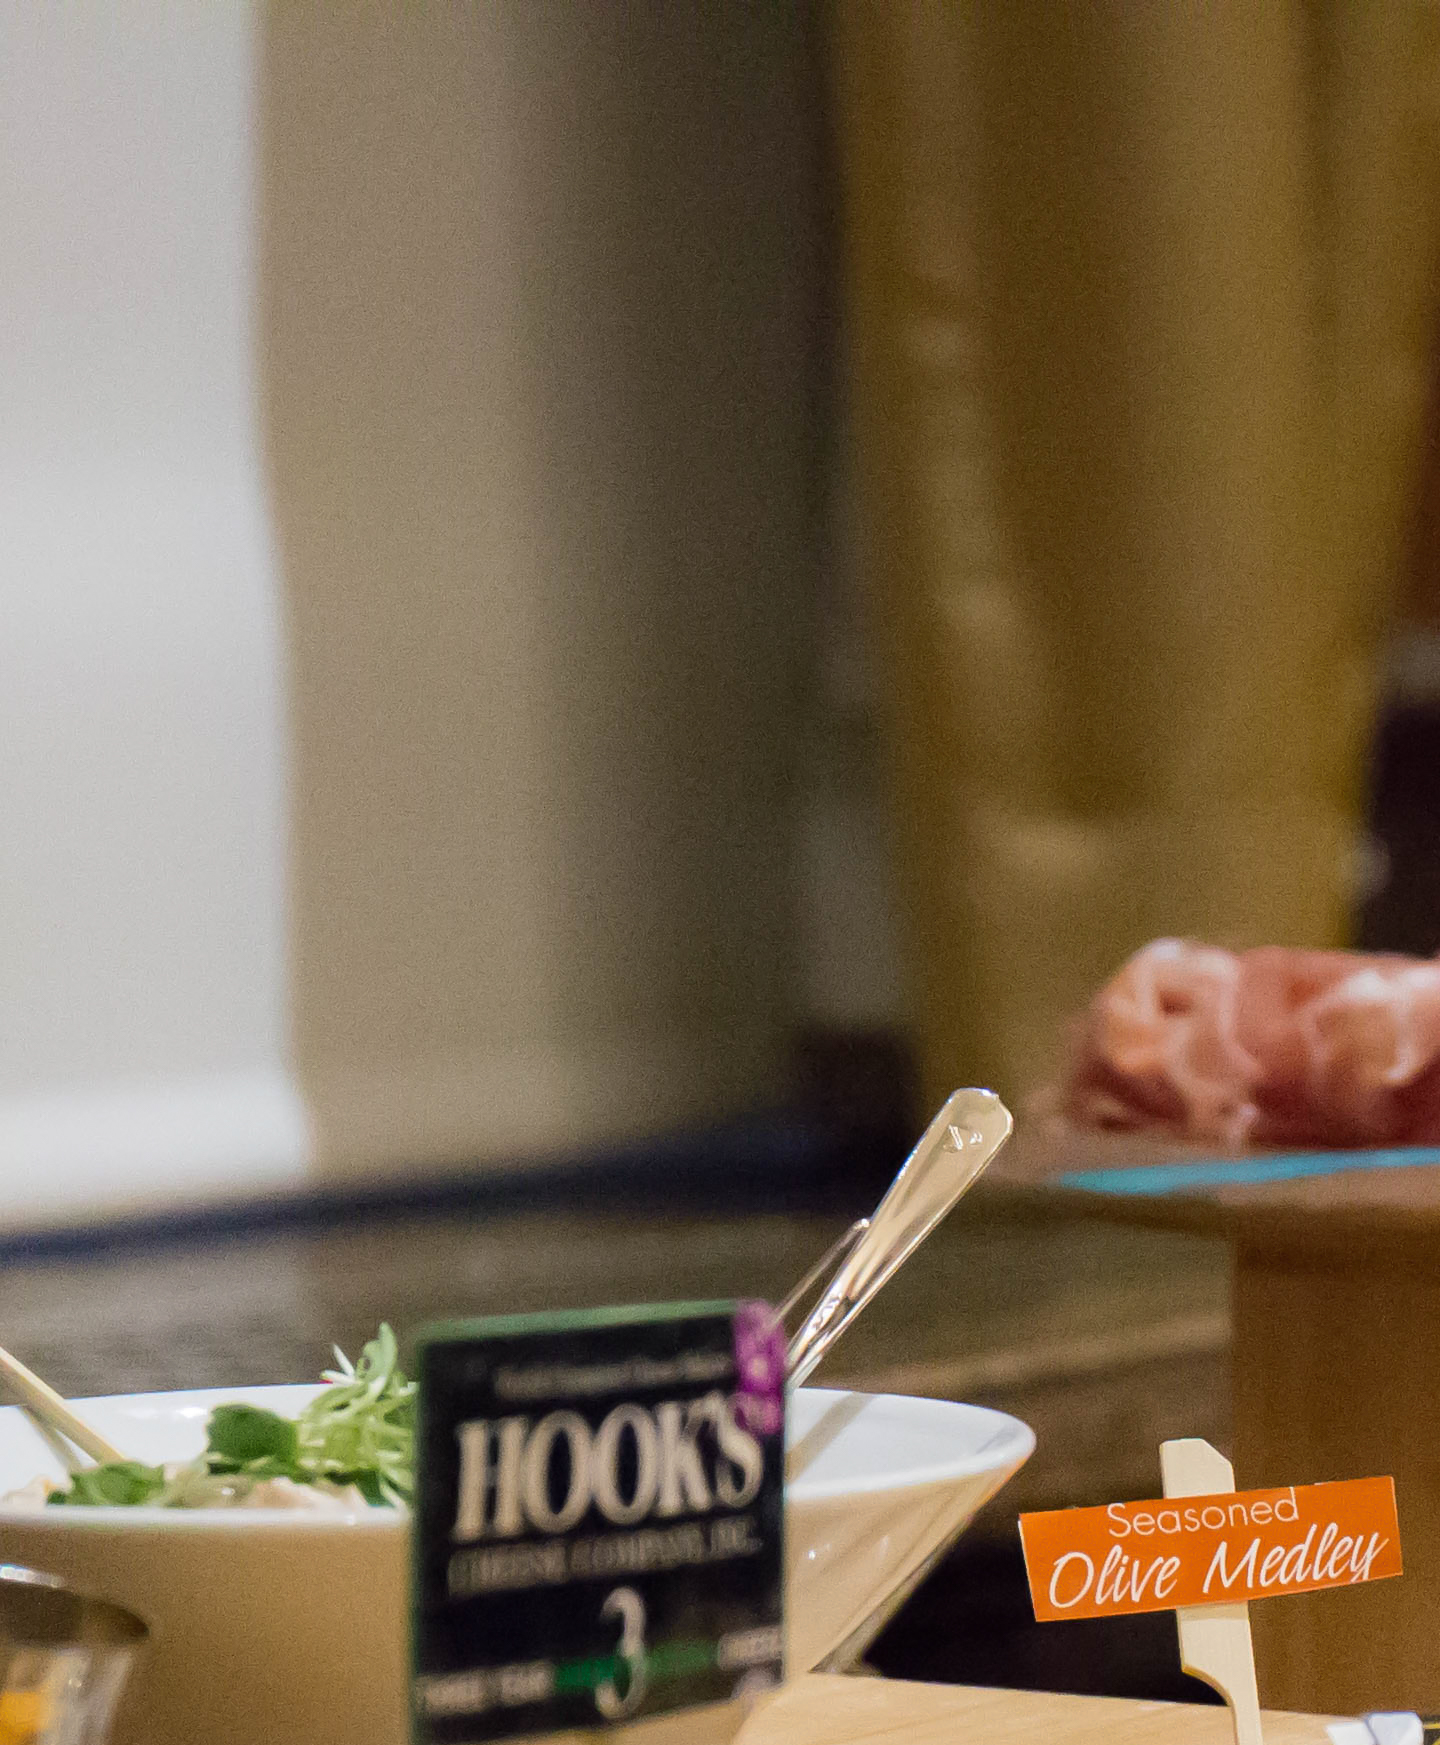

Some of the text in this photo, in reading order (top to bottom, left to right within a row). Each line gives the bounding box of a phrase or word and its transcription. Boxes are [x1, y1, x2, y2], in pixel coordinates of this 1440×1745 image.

[1107, 1486, 1299, 1539] Seasoned
[1048, 1522, 1390, 1610] Olive Medley
[595, 1584, 646, 1719] 3
